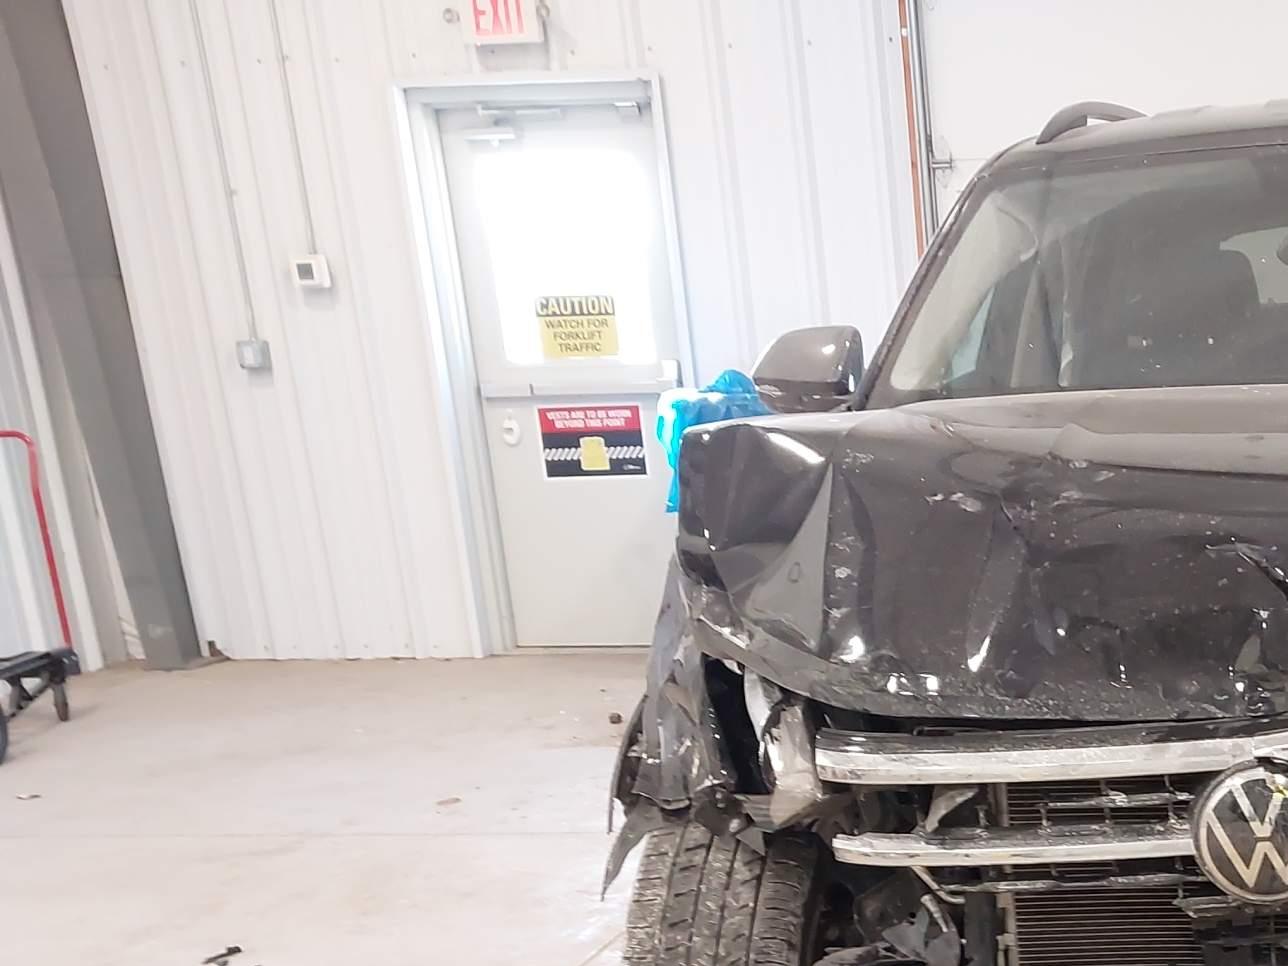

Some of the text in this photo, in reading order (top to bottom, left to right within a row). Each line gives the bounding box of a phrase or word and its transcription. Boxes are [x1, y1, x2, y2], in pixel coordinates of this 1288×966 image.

[536, 295, 615, 316] CAUTION
[544, 318, 609, 329] WATCH FOR
[553, 330, 602, 341] FORKLIFT
[559, 341, 602, 353] TRAFFIC
